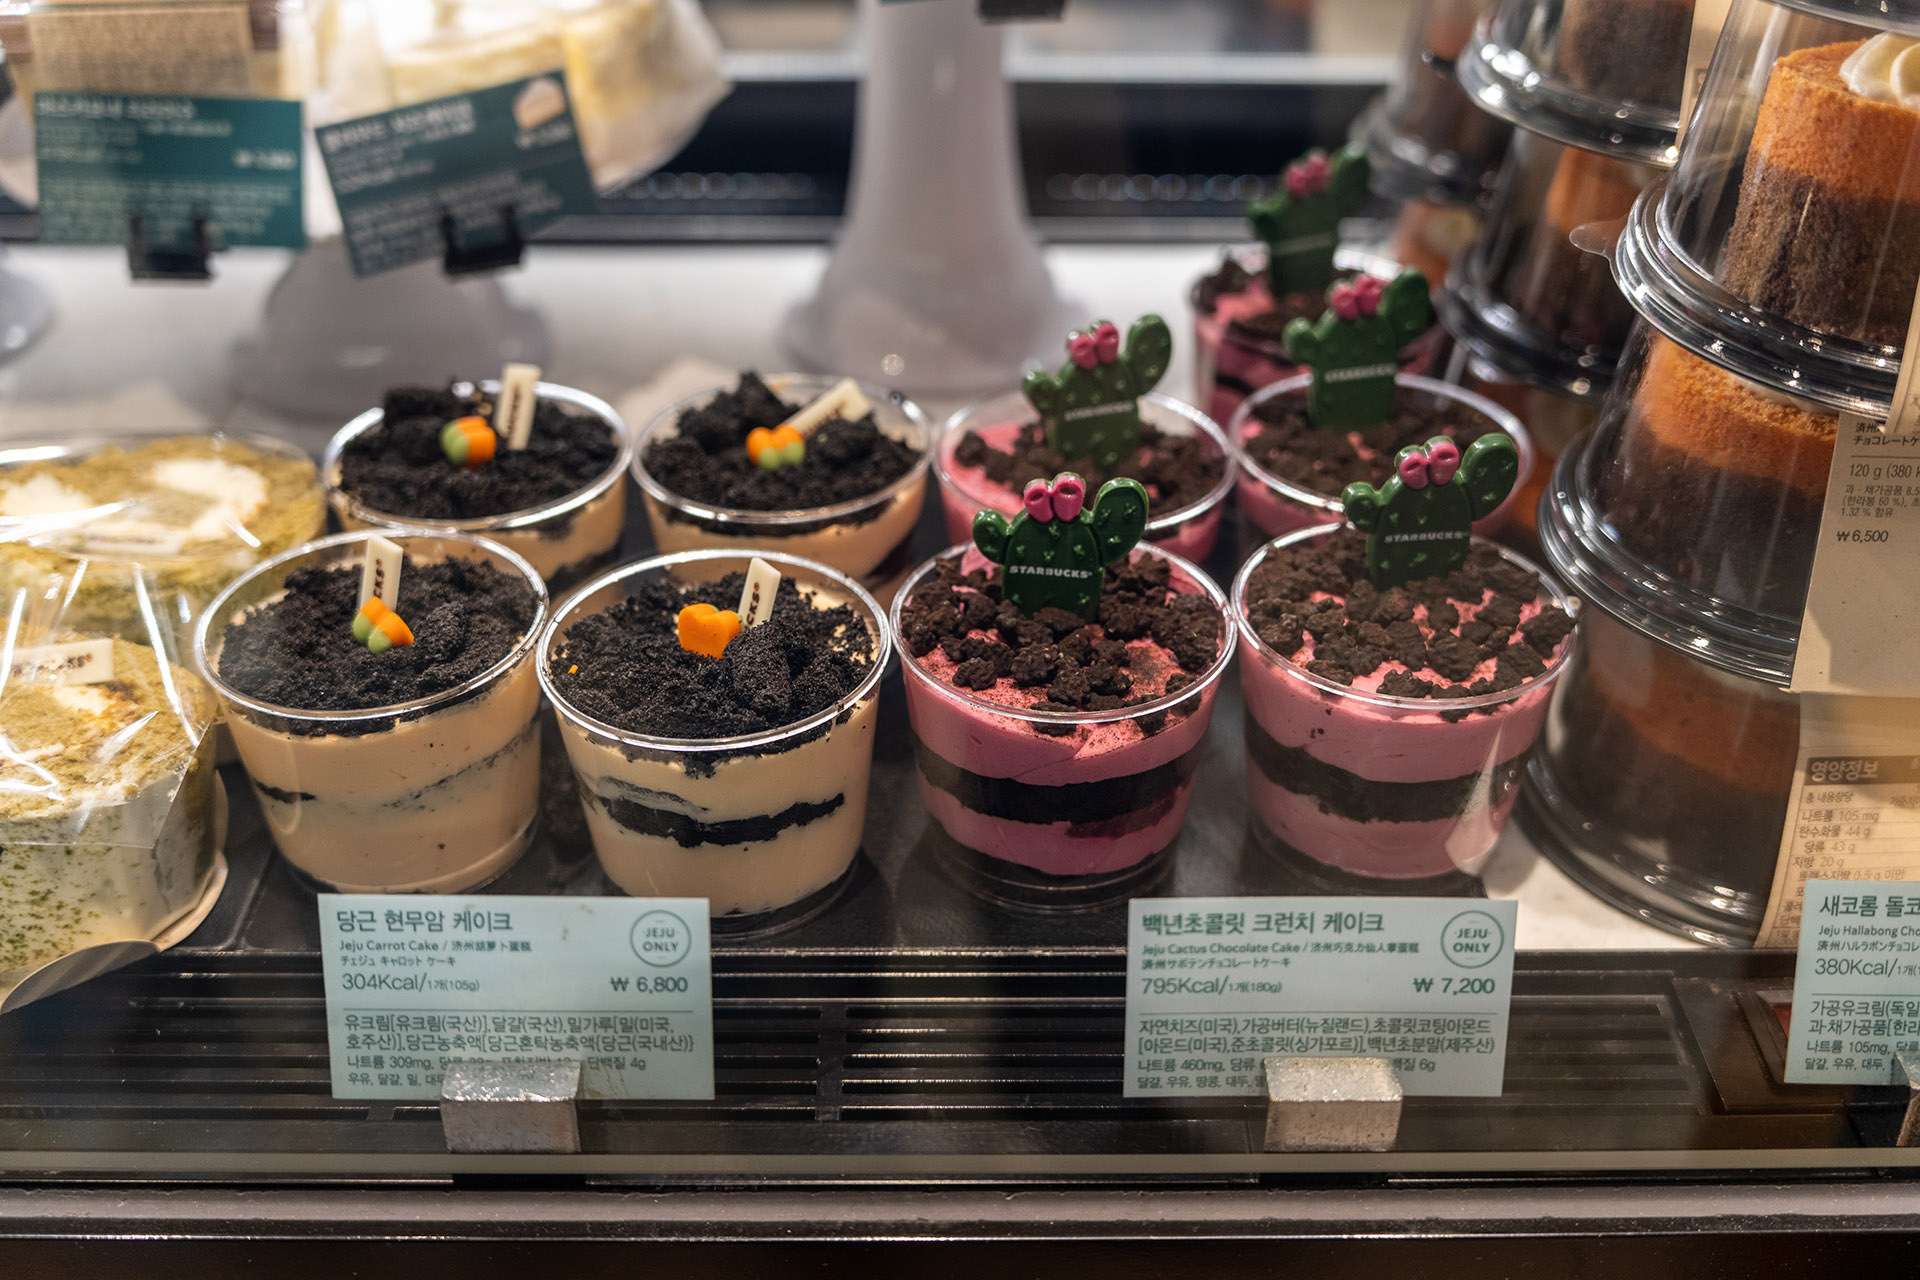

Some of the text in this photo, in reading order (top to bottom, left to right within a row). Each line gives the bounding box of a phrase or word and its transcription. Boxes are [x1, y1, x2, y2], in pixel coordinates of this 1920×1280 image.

[1850, 463, 1870, 477] 120
[1873, 467, 1881, 480] g
[1886, 463, 1912, 478] (380
[1811, 760, 1879, 782] 영양정보
[1802, 809, 1879, 823] 나트륨 105 mg
[1792, 857, 1814, 868] 지방
[1820, 895, 1878, 917] 새코롬
[337, 909, 513, 933] 당근 현무암 케이크
[1142, 911, 1384, 935] 백년초콜릿 크런치 케이크
[646, 927, 675, 938] JEJU
[1456, 928, 1488, 939] JEJU
[1818, 925, 1840, 938] Jeju
[1843, 926, 1898, 939] Hallabong
[339, 940, 363, 953] Jeju
[366, 940, 405, 951] Carrot
[408, 940, 439, 951] Cake
[643, 941, 679, 952] ONLY
[1142, 945, 1165, 956] Jeju
[1168, 944, 1207, 954] Cactus
[1209, 943, 1268, 953] Chocolate
[1271, 942, 1300, 953] Cake
[1452, 942, 1491, 953] ONLY
[340, 956, 456, 967] チェジュ キャロット ケーキ
[637, 976, 689, 994] 6,800
[1441, 978, 1496, 995] 7,200
[1811, 1000, 1920, 1018] 가공유크림(독일
[1806, 1041, 1843, 1053] 나트륨
[1849, 1041, 1890, 1055] 105mg,
[347, 1055, 385, 1069] 나트륨
[389, 1056, 434, 1070] 309mg,
[588, 1057, 626, 1070] 단백질
[630, 1057, 646, 1070] 4g
[1138, 1058, 1176, 1072] 나트륨
[1181, 1058, 1225, 1073] 460mg,
[1230, 1058, 1255, 1071] 당류
[1419, 1058, 1436, 1072] 6g
